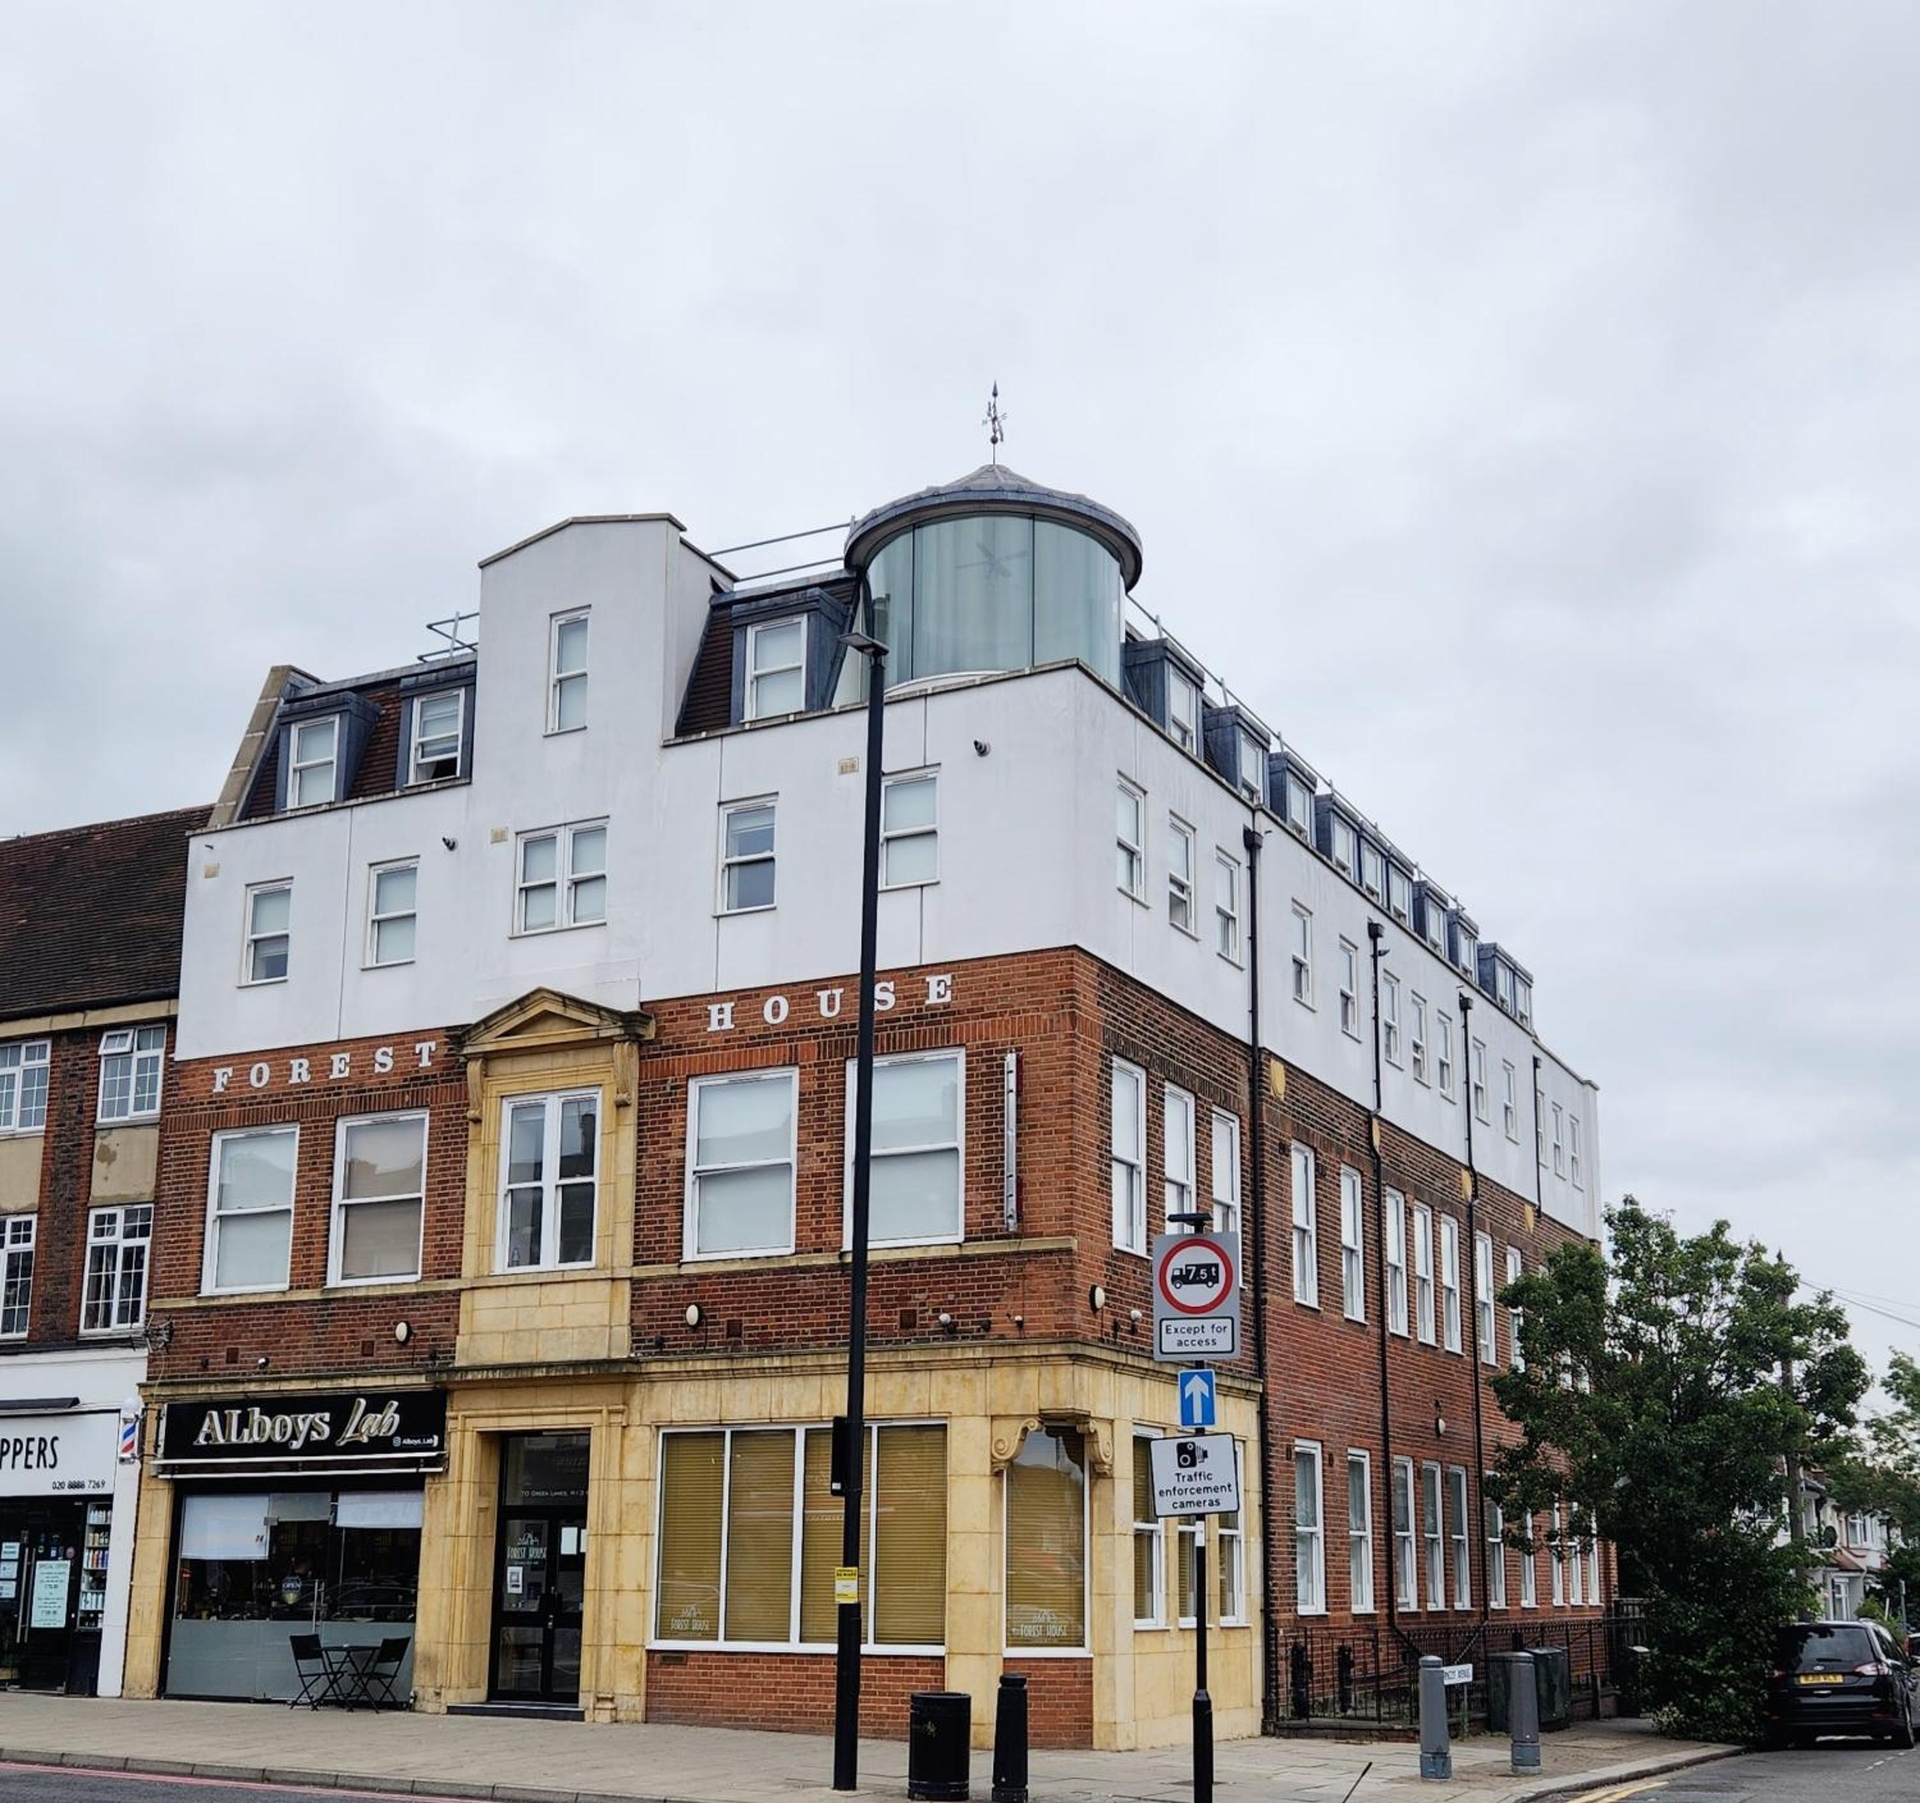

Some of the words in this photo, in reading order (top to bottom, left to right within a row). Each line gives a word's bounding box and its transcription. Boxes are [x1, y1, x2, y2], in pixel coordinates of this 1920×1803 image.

[212, 1041, 436, 1093] FOREST
[707, 974, 952, 1032] HOUSE
[1165, 1324, 1206, 1336] Except
[1211, 1323, 1228, 1334] for
[1177, 1339, 1217, 1347] access
[335, 1397, 400, 1447] Lab
[1175, 1471, 1213, 1483] Traffic
[52, 1481, 66, 1490] 020
[1158, 1482, 1233, 1498] enforcement
[1171, 1498, 1221, 1510] cameras
